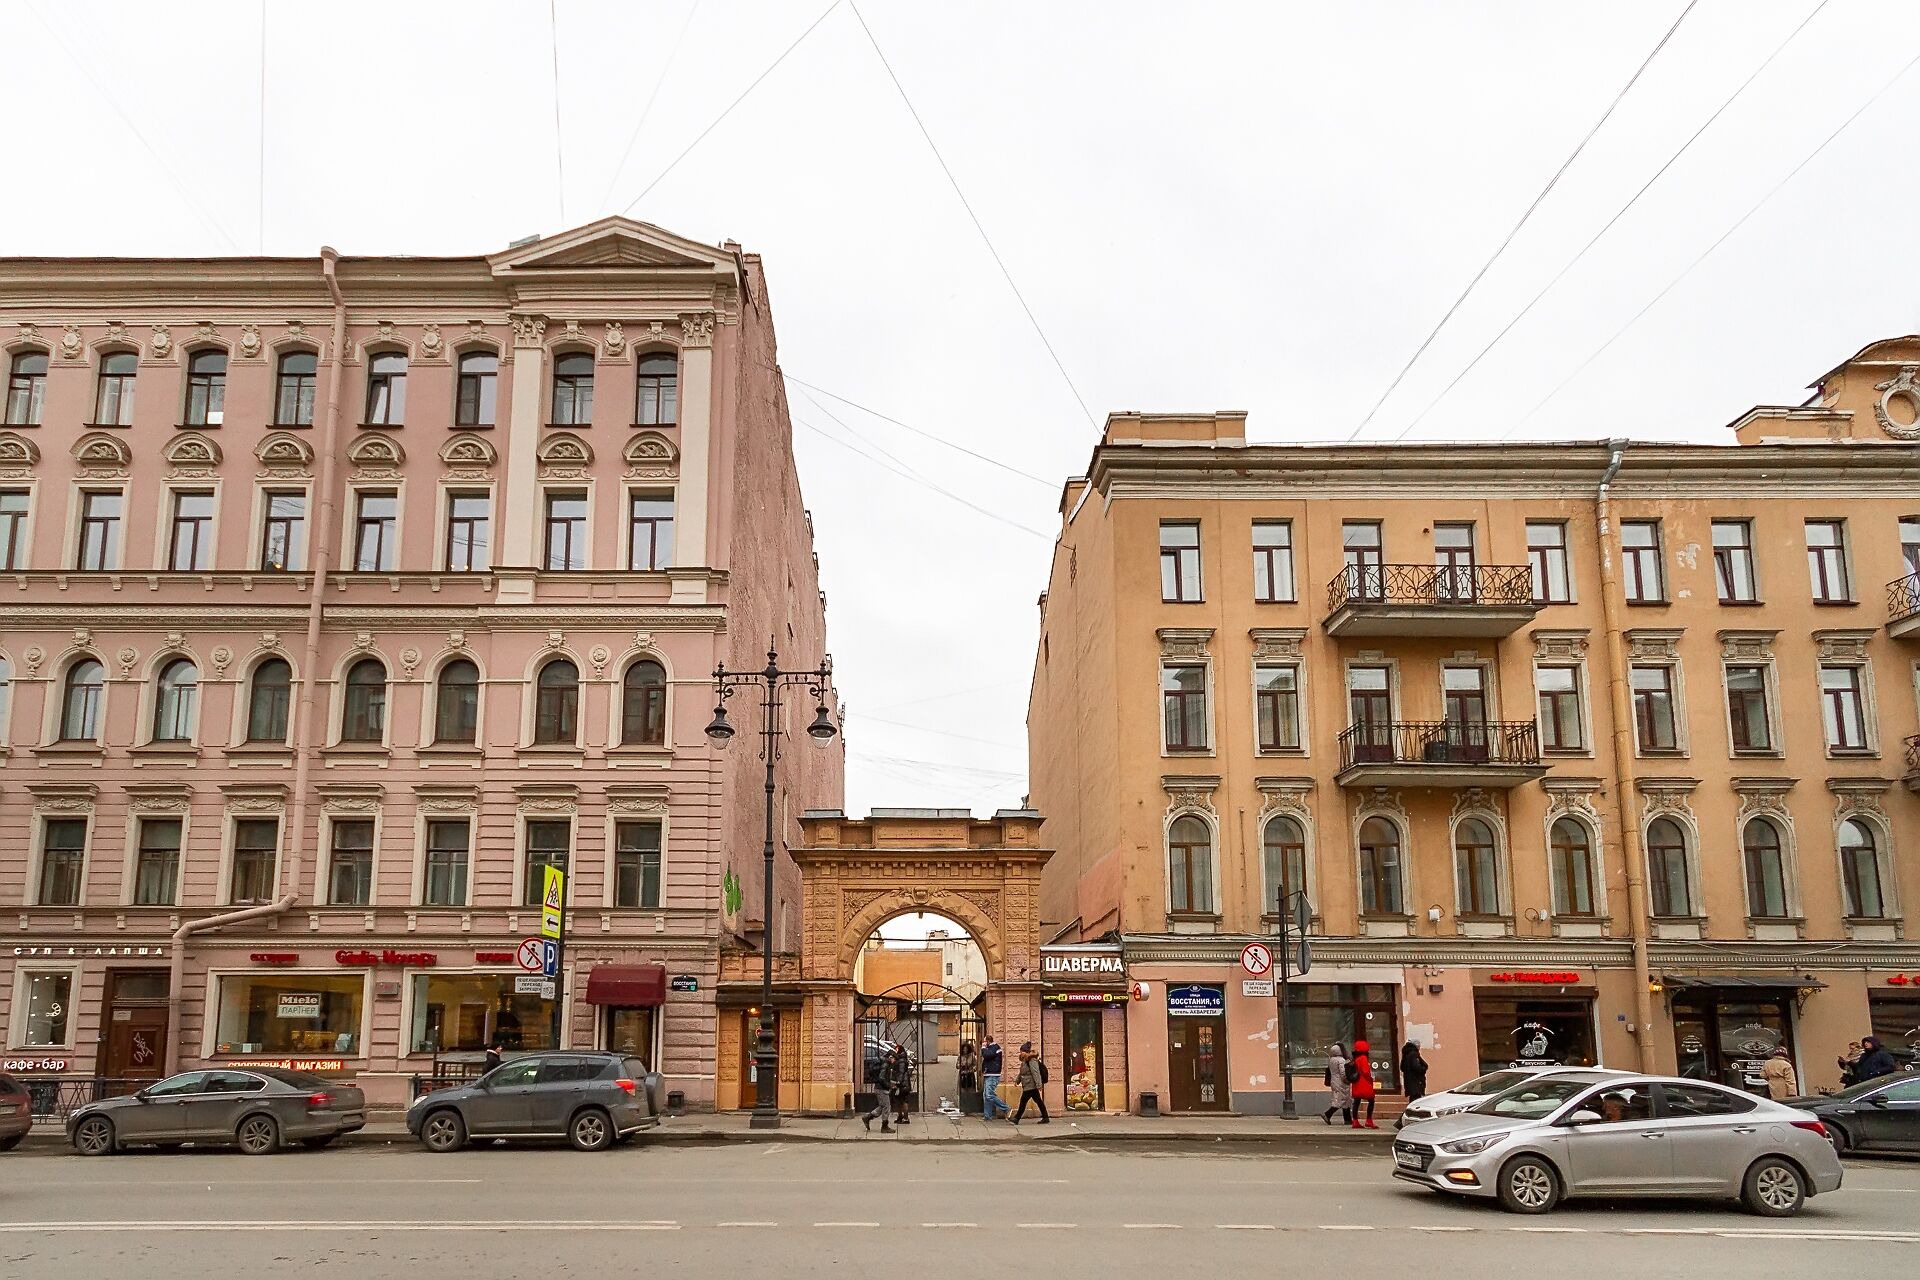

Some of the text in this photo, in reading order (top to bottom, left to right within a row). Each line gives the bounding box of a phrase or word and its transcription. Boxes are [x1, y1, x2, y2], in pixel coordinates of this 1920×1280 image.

[14, 947, 162, 955] СУП & ЛАПША
[547, 945, 554, 972] P
[1045, 957, 1124, 972] ШАВЕРМА
[281, 996, 318, 1004] Miele
[1170, 998, 1212, 1006] ВОССТАНИЯ,
[282, 1006, 316, 1015] ПАРТНЕР
[3, 1058, 65, 1071] кафе бар
[296, 1061, 341, 1070] МАГАЗИН
